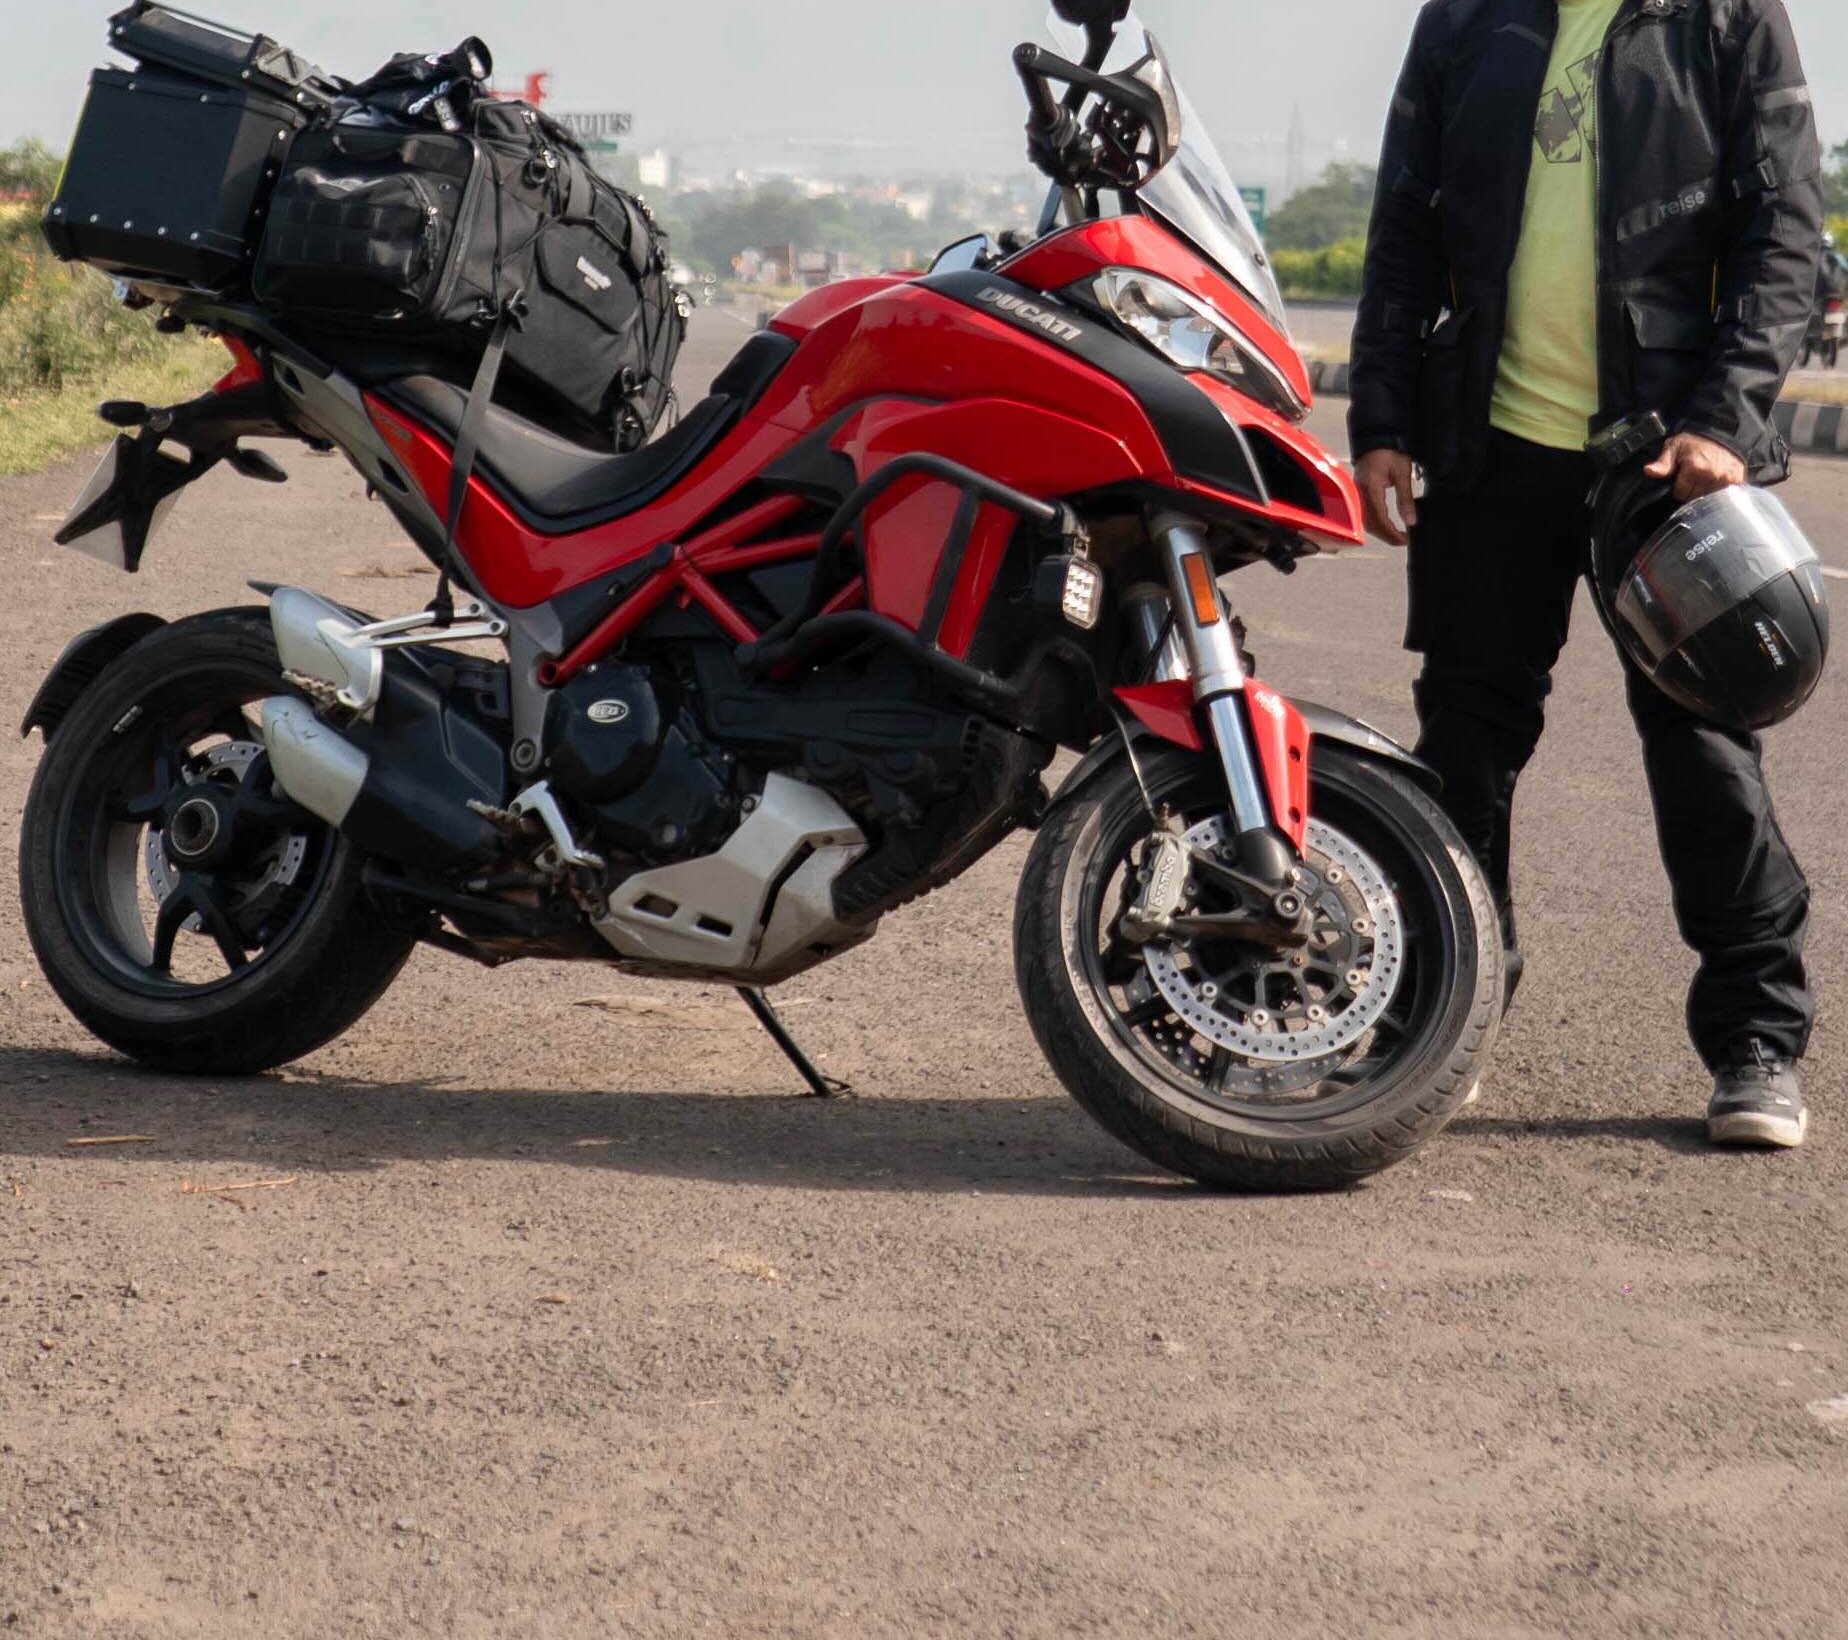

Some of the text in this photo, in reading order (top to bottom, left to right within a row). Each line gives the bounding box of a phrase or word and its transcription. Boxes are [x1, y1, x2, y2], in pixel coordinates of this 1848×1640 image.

[1656, 190, 1706, 218] reise
[975, 287, 1083, 341] DUCATI
[1685, 529, 1724, 561] reise
[1150, 855, 1175, 907] brembo
